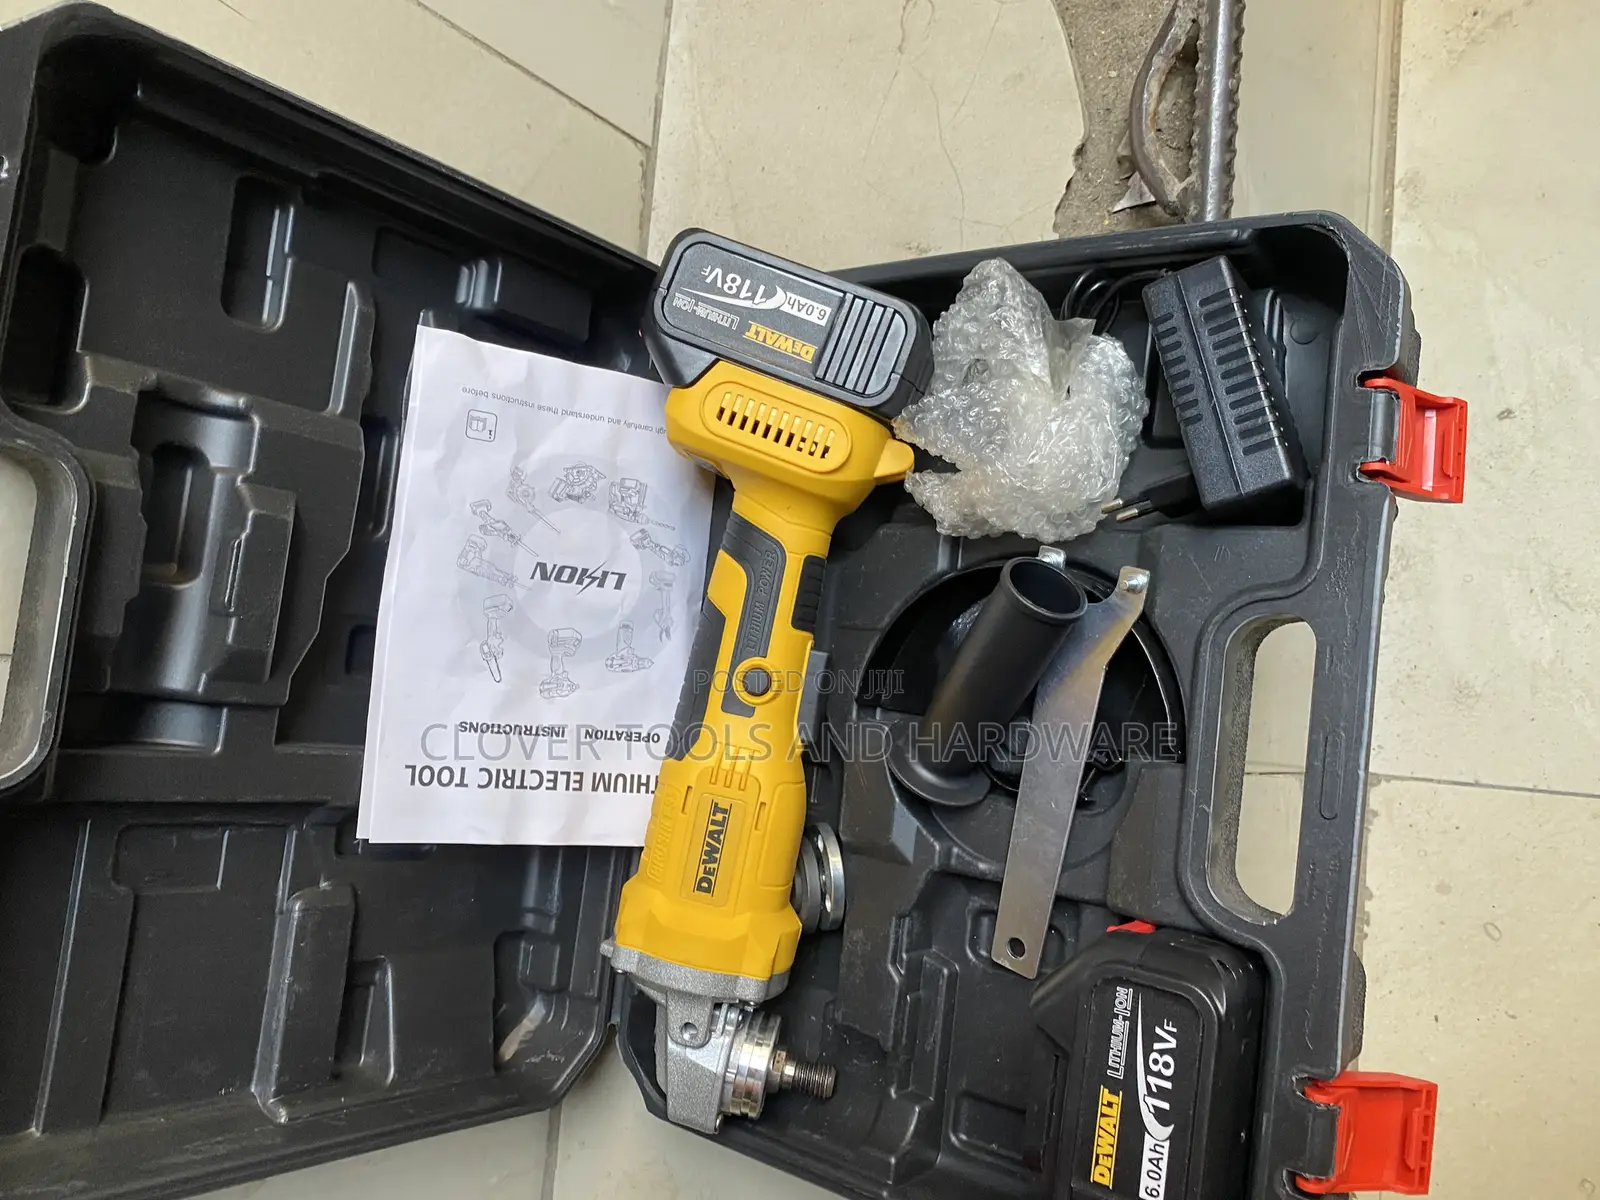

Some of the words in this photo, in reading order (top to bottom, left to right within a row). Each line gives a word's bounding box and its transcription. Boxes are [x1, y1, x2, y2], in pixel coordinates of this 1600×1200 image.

[787, 296, 827, 320] 6.0Ah
[461, 386, 489, 399] before
[491, 392, 535, 408] instructions
[537, 404, 559, 415] these
[561, 408, 605, 422] understand
[623, 419, 653, 432] carefully
[747, 601, 765, 651] LITHIUM
[757, 550, 777, 596] POWER
[458, 720, 565, 738] INSTRUCTIONS
[584, 728, 661, 743] OPERATION
[404, 764, 469, 787] TOOL
[477, 768, 584, 791] ELECTRIC
[1107, 986, 1133, 1079] LITHIUM-ION
[1145, 1143, 1165, 1198] 6.0Ah
